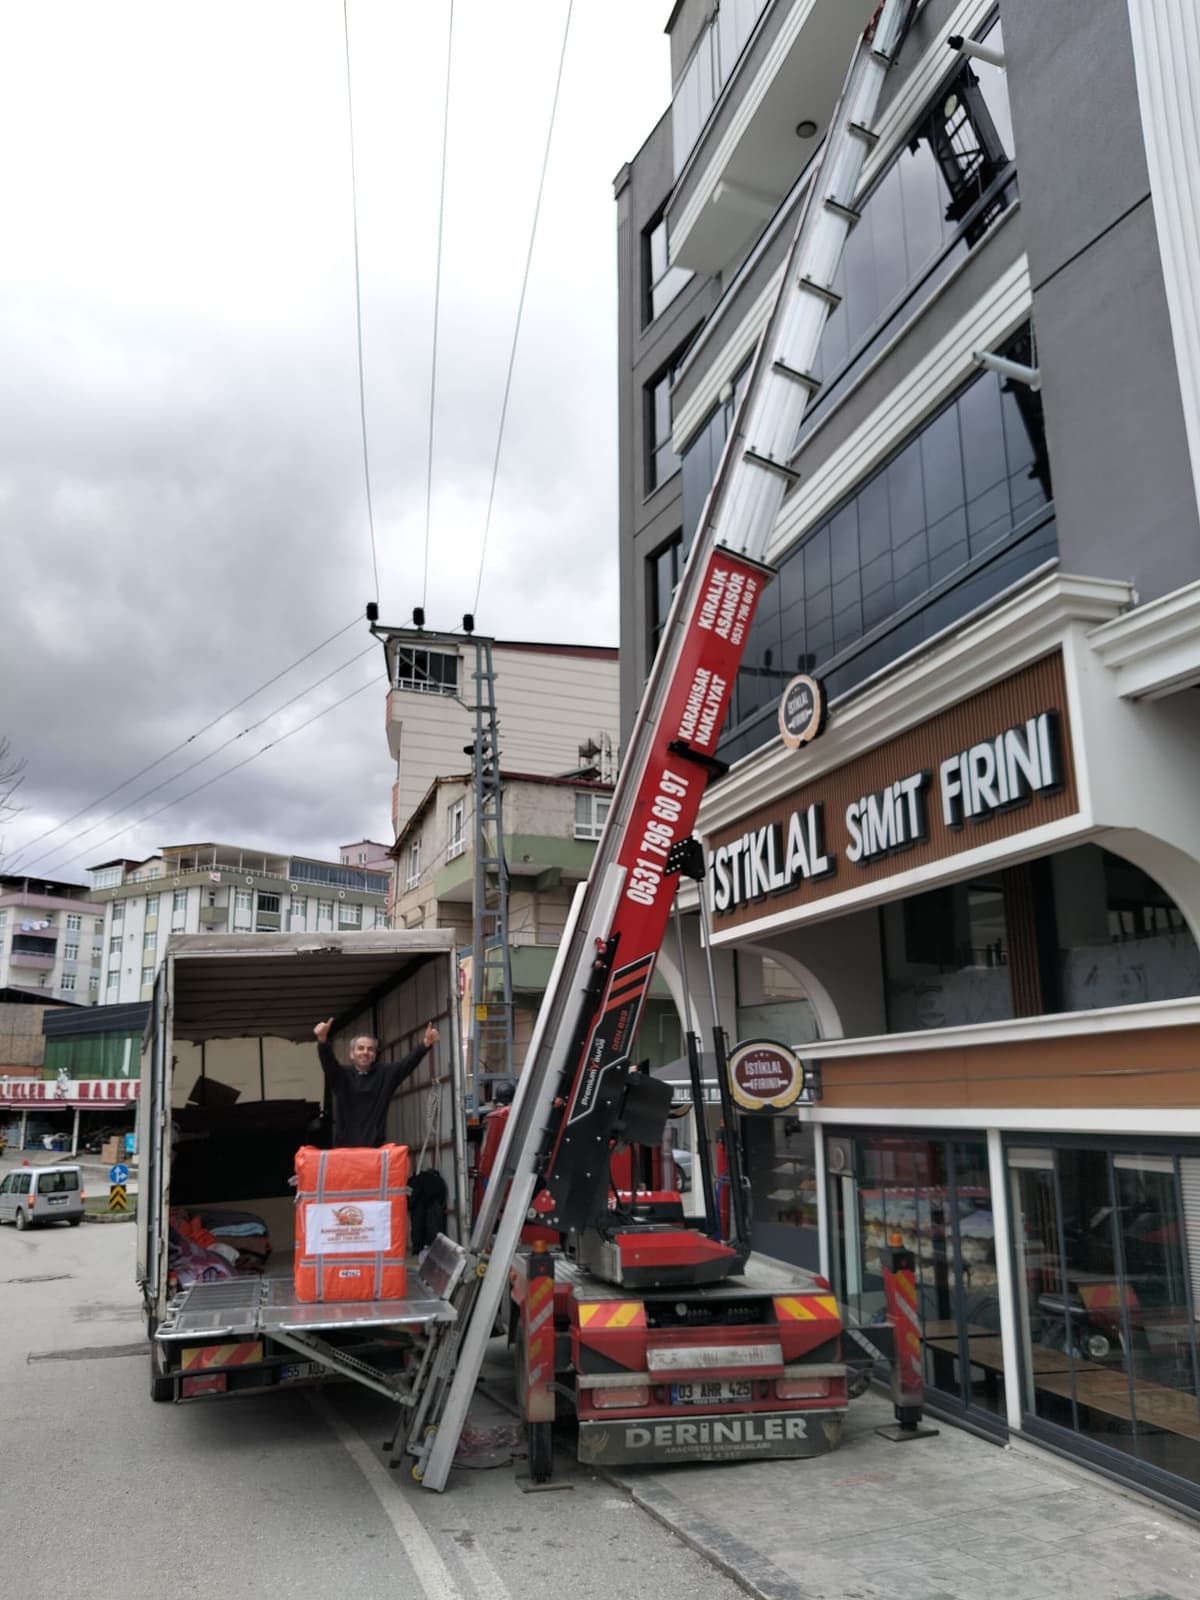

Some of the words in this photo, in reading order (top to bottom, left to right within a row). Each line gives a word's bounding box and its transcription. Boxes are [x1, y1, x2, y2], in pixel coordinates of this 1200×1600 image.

[715, 572, 745, 639] ASANSÖR
[659, 769, 689, 798] 97
[940, 713, 1054, 826] FIRINI
[651, 795, 682, 822] 60
[640, 821, 674, 857] 796
[626, 858, 663, 906] 0531
[679, 1384, 693, 1398] 03
